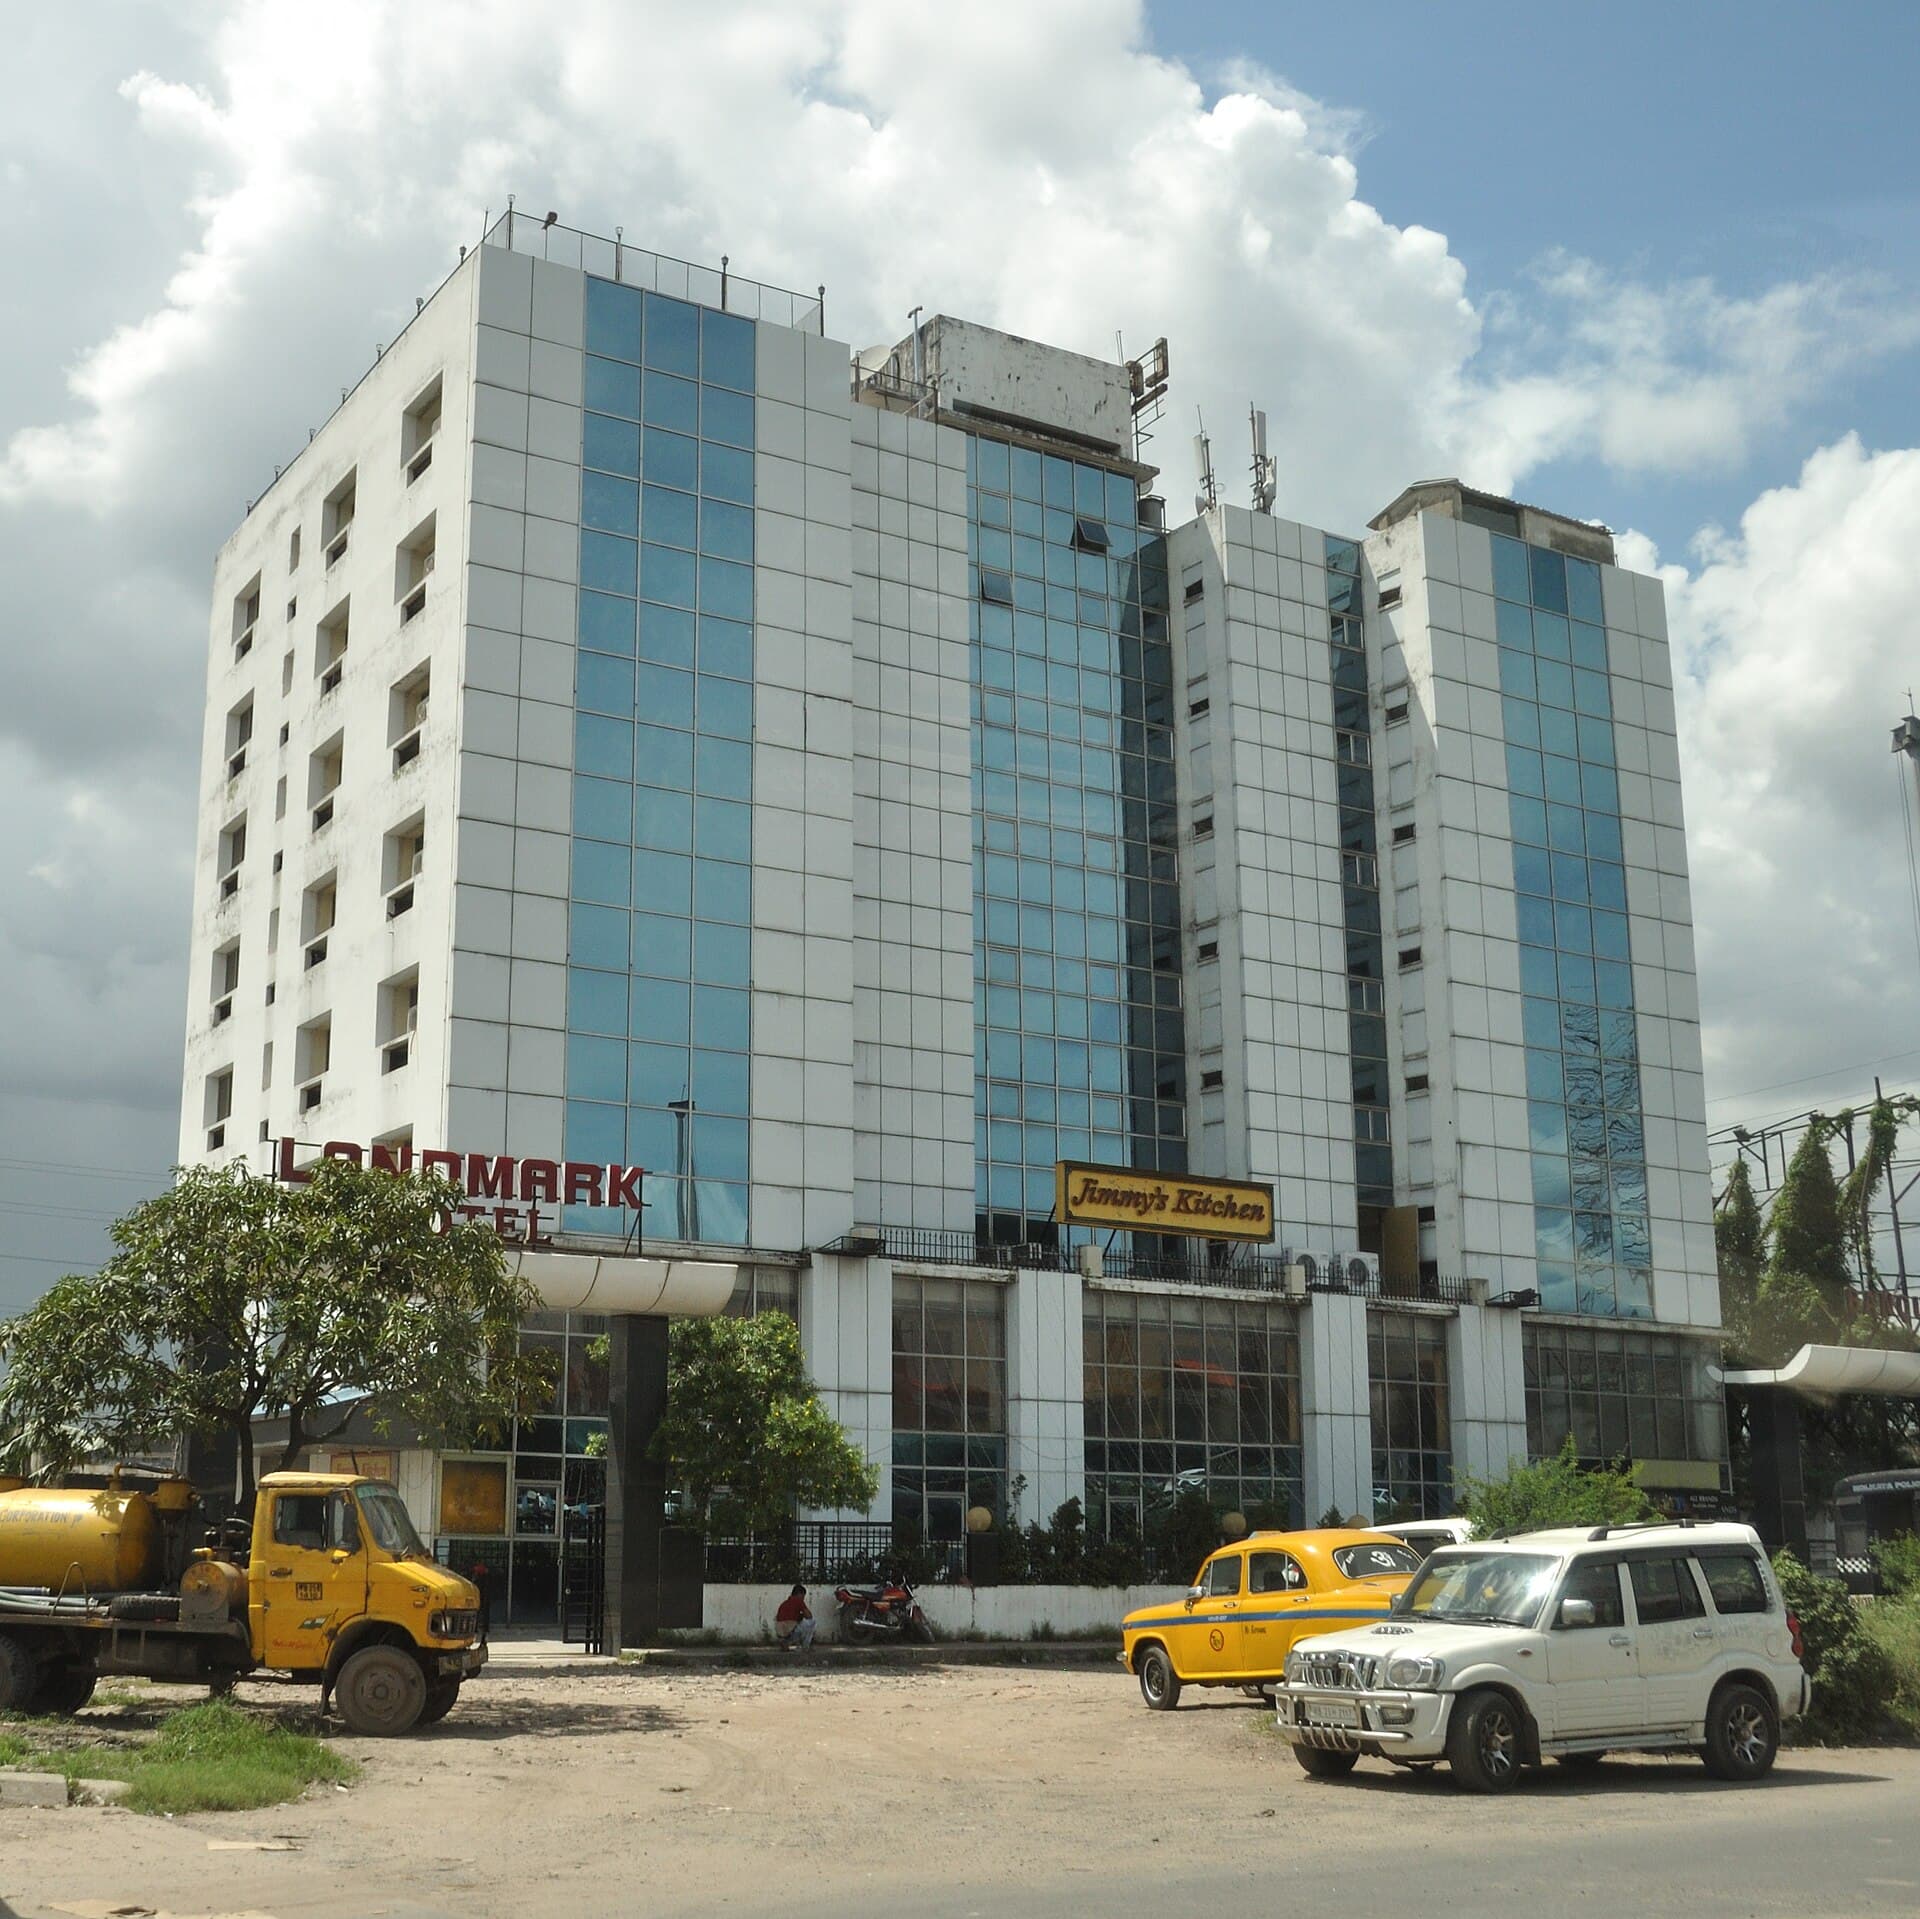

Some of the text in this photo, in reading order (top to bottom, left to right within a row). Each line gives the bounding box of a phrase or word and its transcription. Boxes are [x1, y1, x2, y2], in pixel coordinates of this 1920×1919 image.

[1071, 1177, 1266, 1222] Jimmy's Kitchen
[428, 1205, 555, 1246] OTEL
